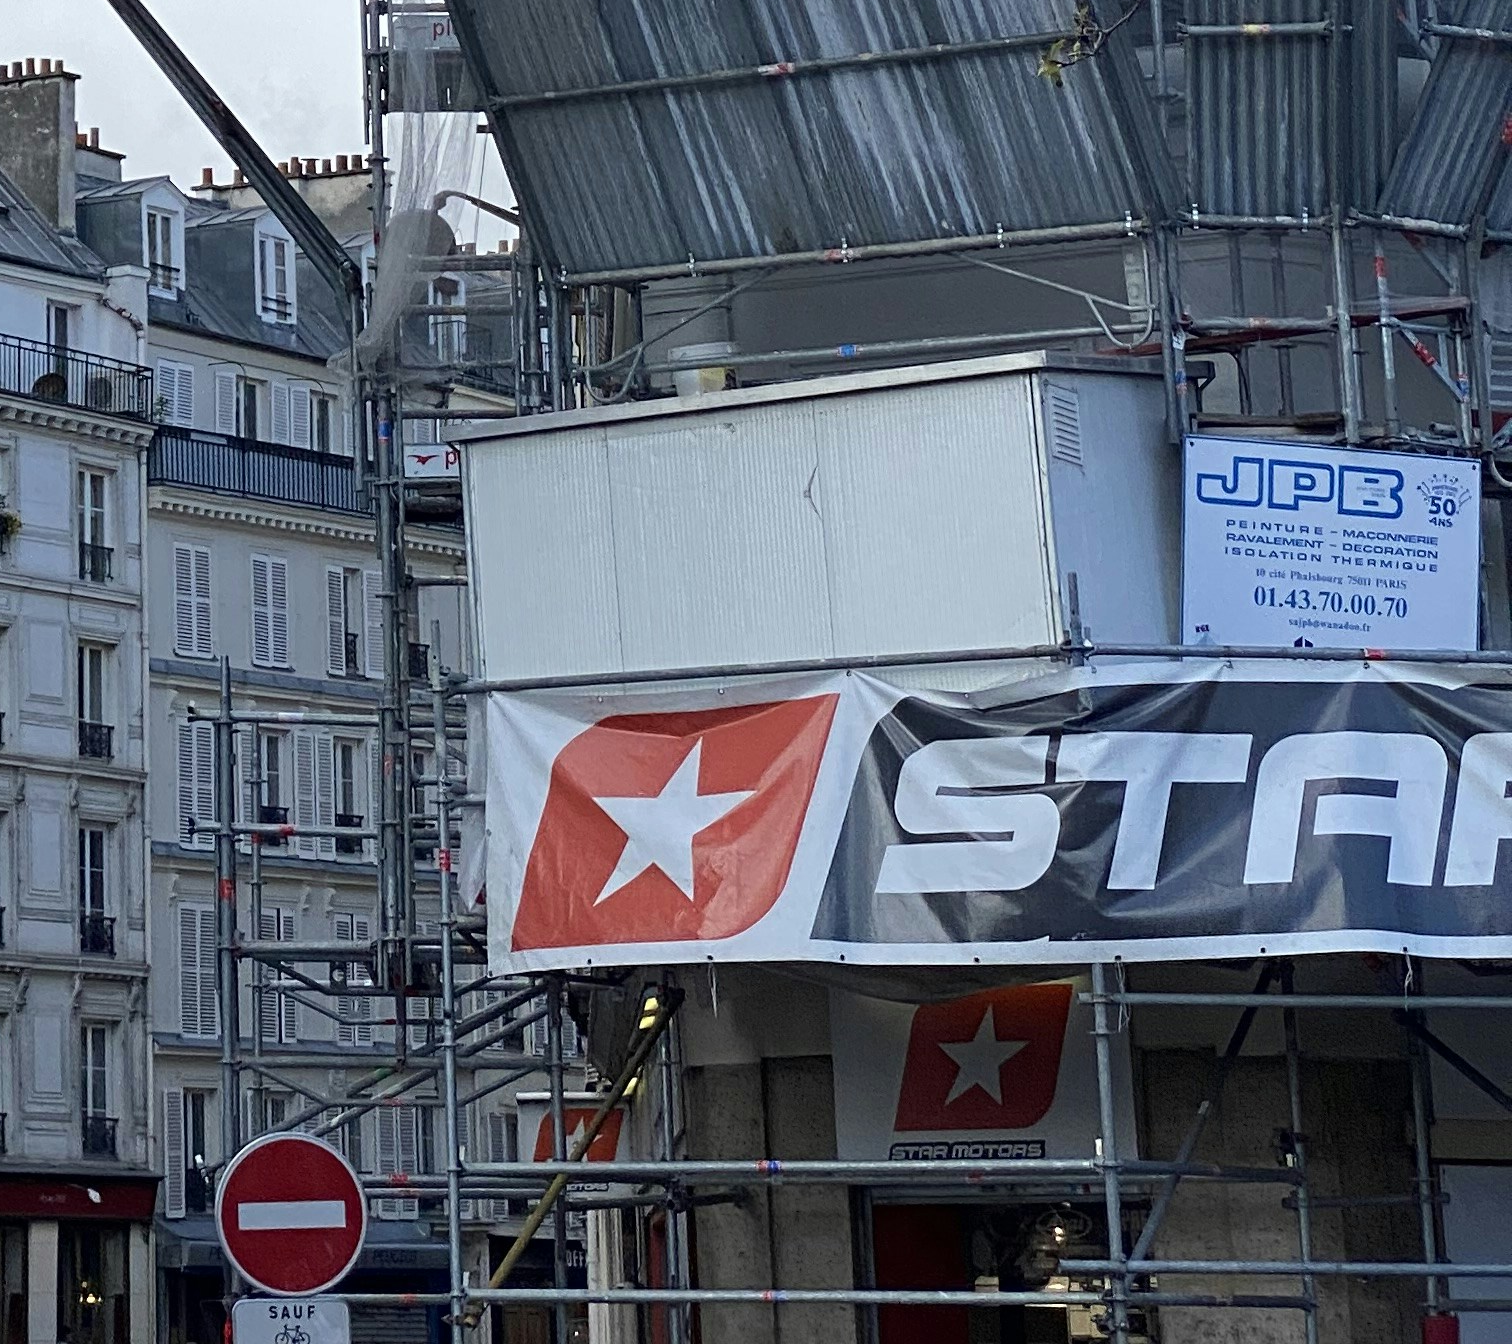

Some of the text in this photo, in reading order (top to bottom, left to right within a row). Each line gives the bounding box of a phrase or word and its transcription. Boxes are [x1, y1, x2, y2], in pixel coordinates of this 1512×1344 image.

[1197, 456, 1404, 520] JPB
[1429, 496, 1456, 516] 50
[1226, 519, 1324, 535] PEINTURE
[1429, 517, 1454, 528] ANS
[1226, 533, 1324, 549] RAVALEMENT
[1342, 543, 1439, 560] DECORATION
[1225, 547, 1438, 573] ISOLATION THERMIQUE
[1256, 568, 1266, 578] 10
[1376, 578, 1407, 590] PARIS
[1254, 585, 1408, 619] 01.43.70.00.70
[892, 1143, 1042, 1160] STAR MOTORS
[269, 1305, 317, 1320] SAUF
